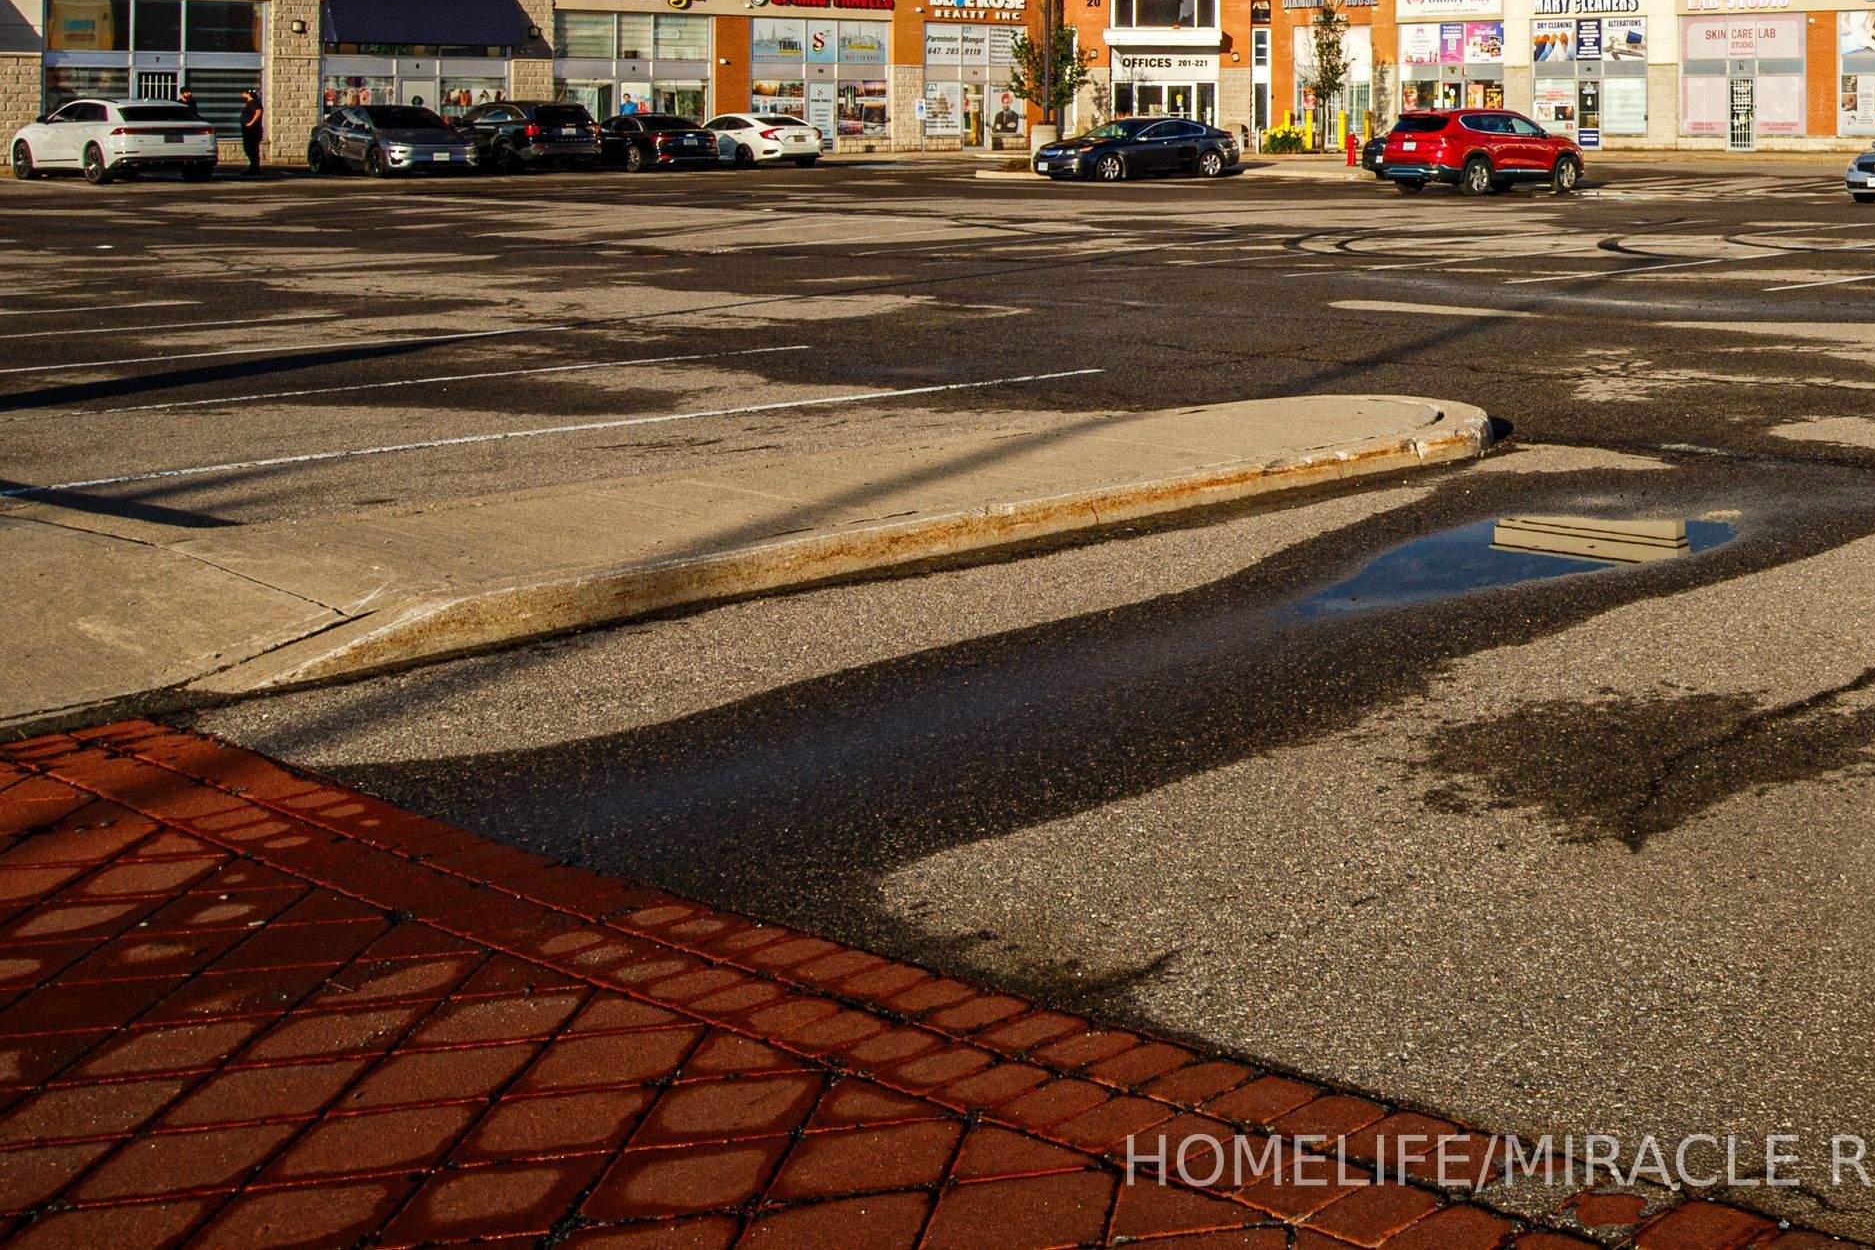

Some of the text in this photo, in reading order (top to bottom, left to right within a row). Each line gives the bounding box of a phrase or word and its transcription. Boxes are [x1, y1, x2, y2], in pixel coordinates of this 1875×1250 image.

[934, 9, 986, 20] REALTY
[927, 35, 985, 44] Parminder Mangat
[1705, 29, 1776, 40] SKIN CARE LAB
[1123, 58, 1172, 68] OFFICES
